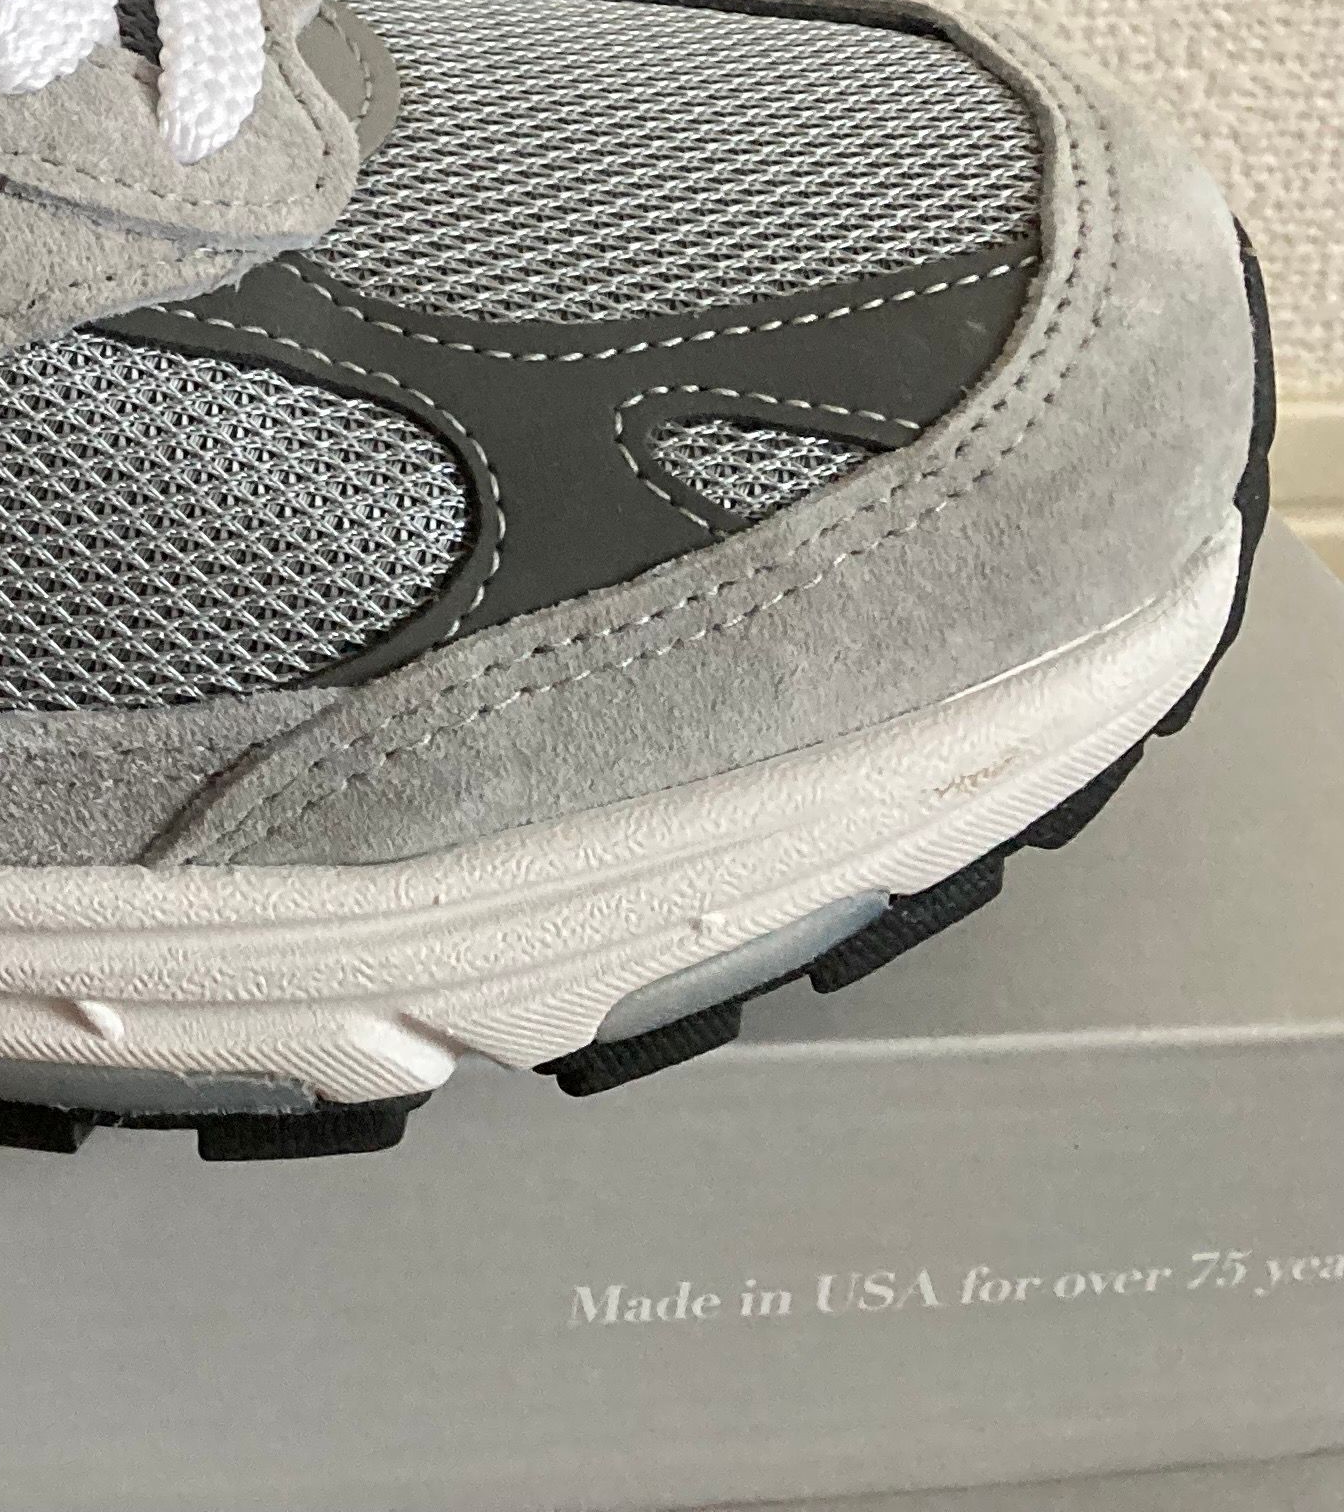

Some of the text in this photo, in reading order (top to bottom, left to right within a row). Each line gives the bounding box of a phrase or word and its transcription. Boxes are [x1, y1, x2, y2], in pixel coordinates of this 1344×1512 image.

[566, 1278, 722, 1329] Made
[738, 1277, 794, 1318] in
[815, 1266, 944, 1311] USA
[961, 1265, 1043, 1305] for
[1052, 1266, 1174, 1301] over
[1186, 1248, 1254, 1291] 75
